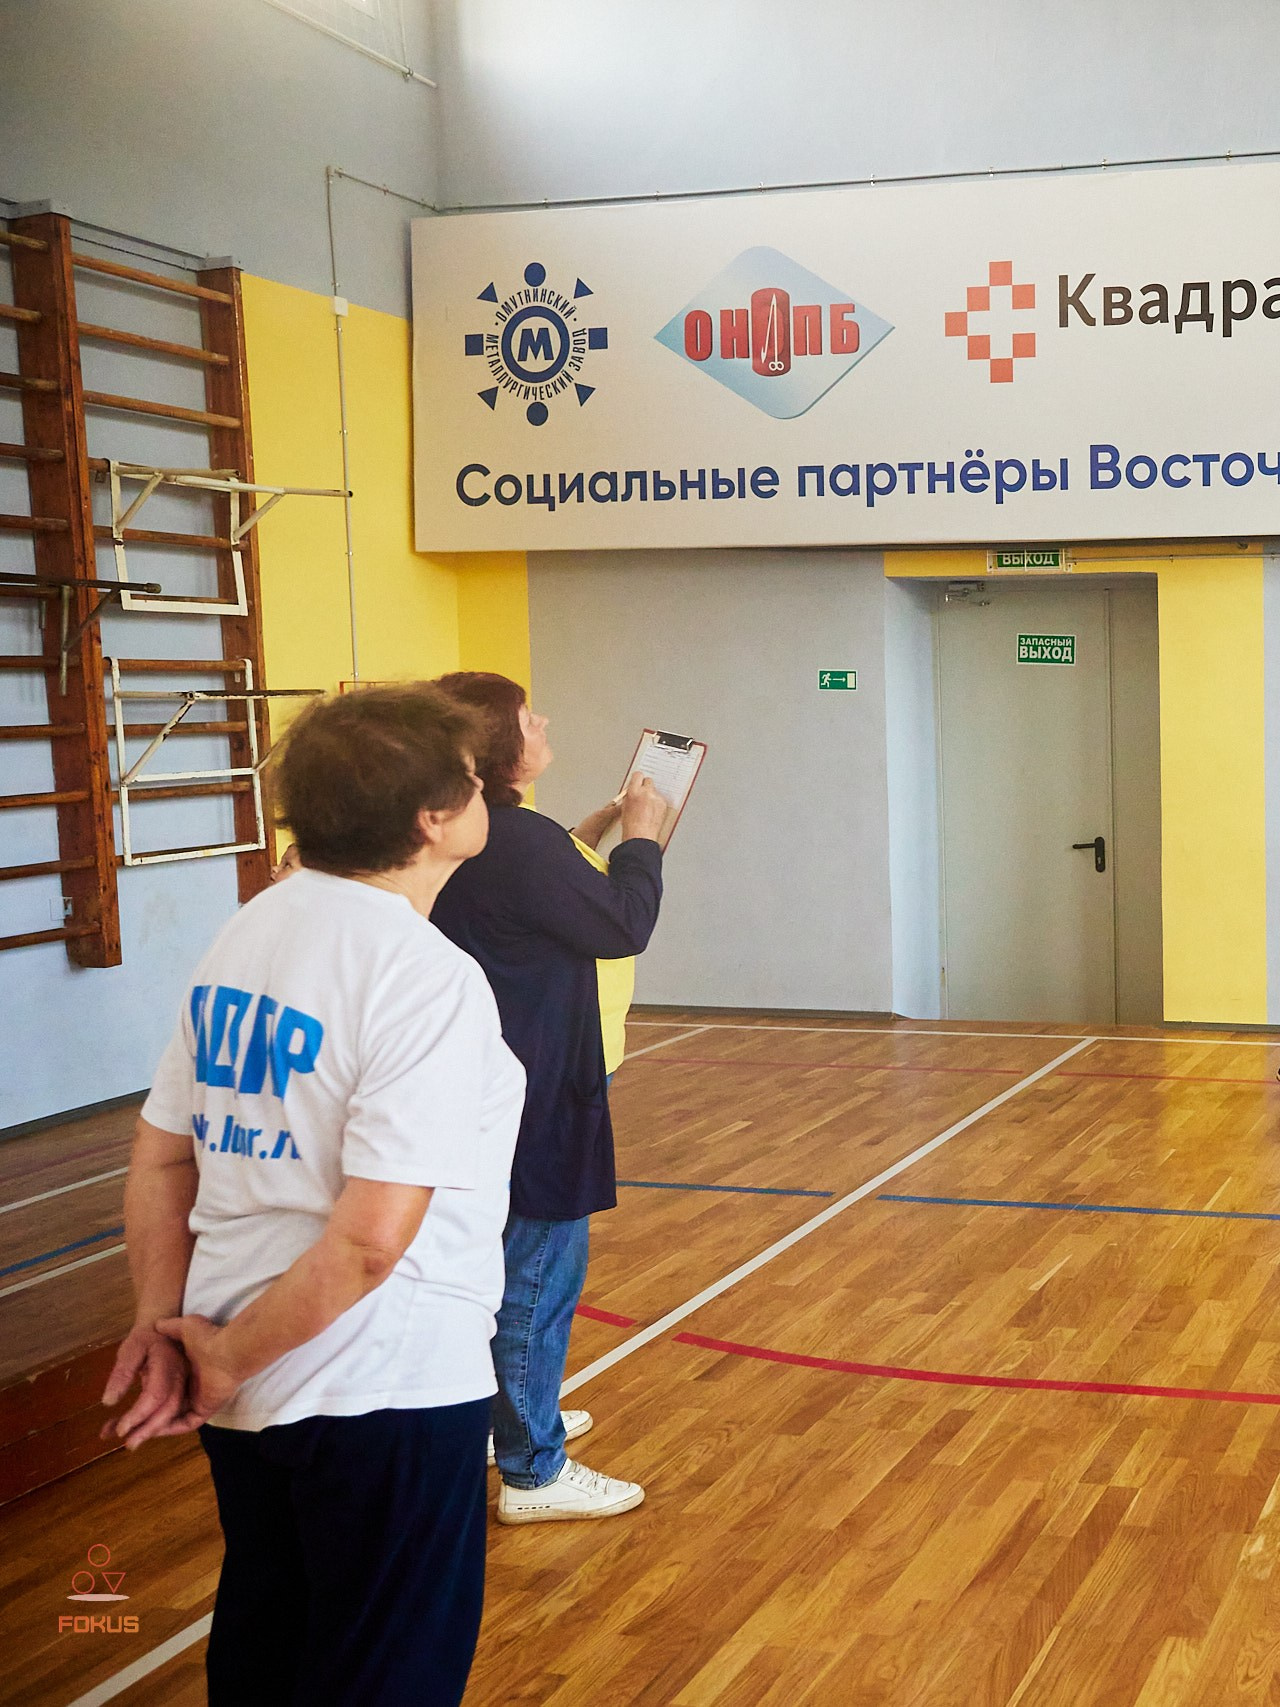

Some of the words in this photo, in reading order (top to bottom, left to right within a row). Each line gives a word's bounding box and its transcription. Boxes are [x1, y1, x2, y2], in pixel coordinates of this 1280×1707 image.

[495, 287, 577, 323] ОМУТНИНСКИЙ
[485, 333, 575, 401] МЕТАЛЛУРГИЧЕСКИЙ
[568, 327, 588, 372] ЗАВОД
[456, 463, 780, 512] Социальные
[798, 449, 1069, 508] партнёры
[1002, 552, 1055, 566] ВЫХОД
[1019, 646, 1073, 662] ВЫХОД
[1020, 637, 1072, 647] ЗАПАСНЫЙ
